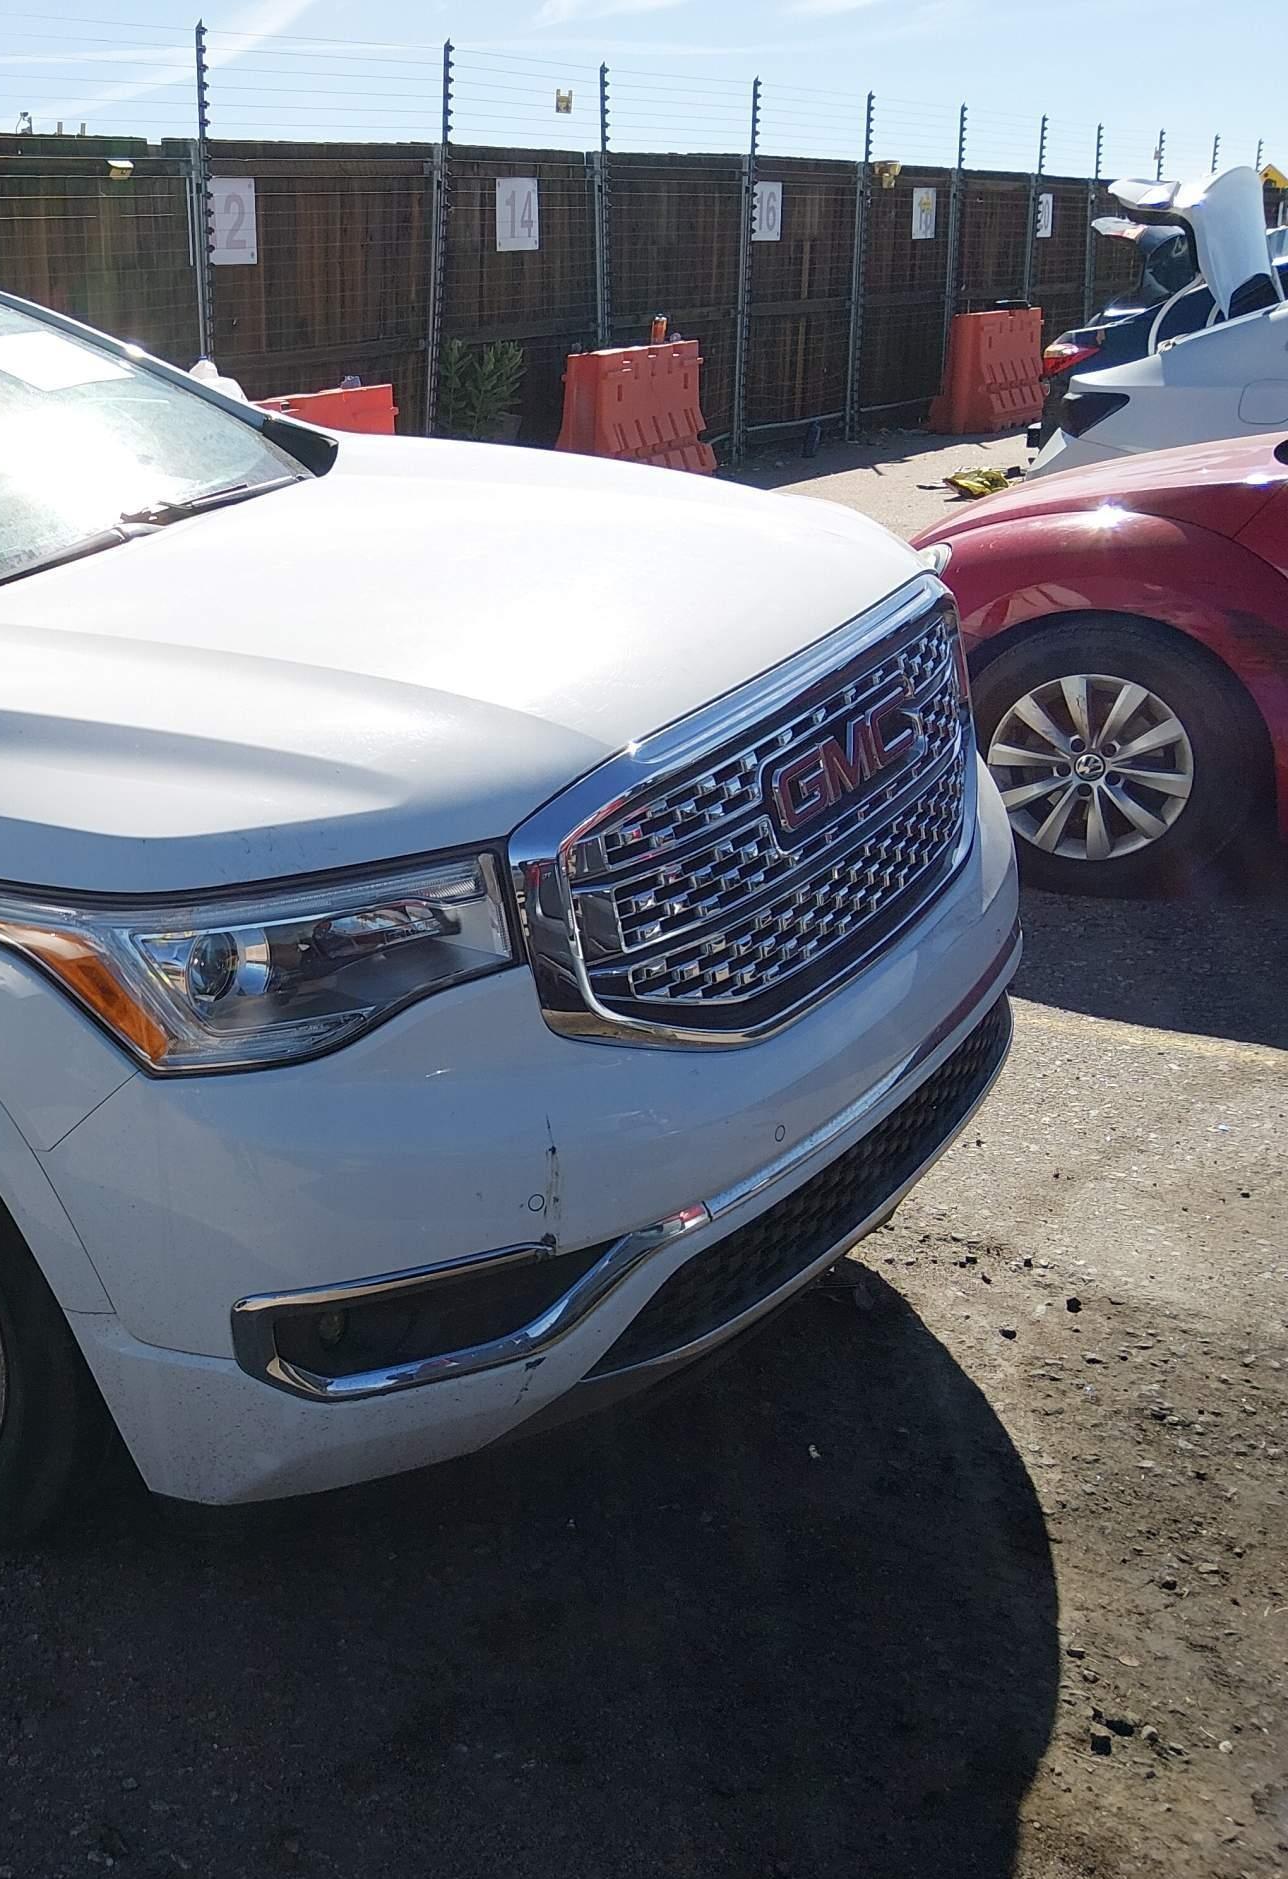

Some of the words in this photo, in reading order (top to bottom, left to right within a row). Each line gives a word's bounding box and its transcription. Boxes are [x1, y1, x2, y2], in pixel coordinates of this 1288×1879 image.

[505, 190, 533, 238] 14
[757, 191, 776, 231] 16
[772, 686, 914, 833] GMC
